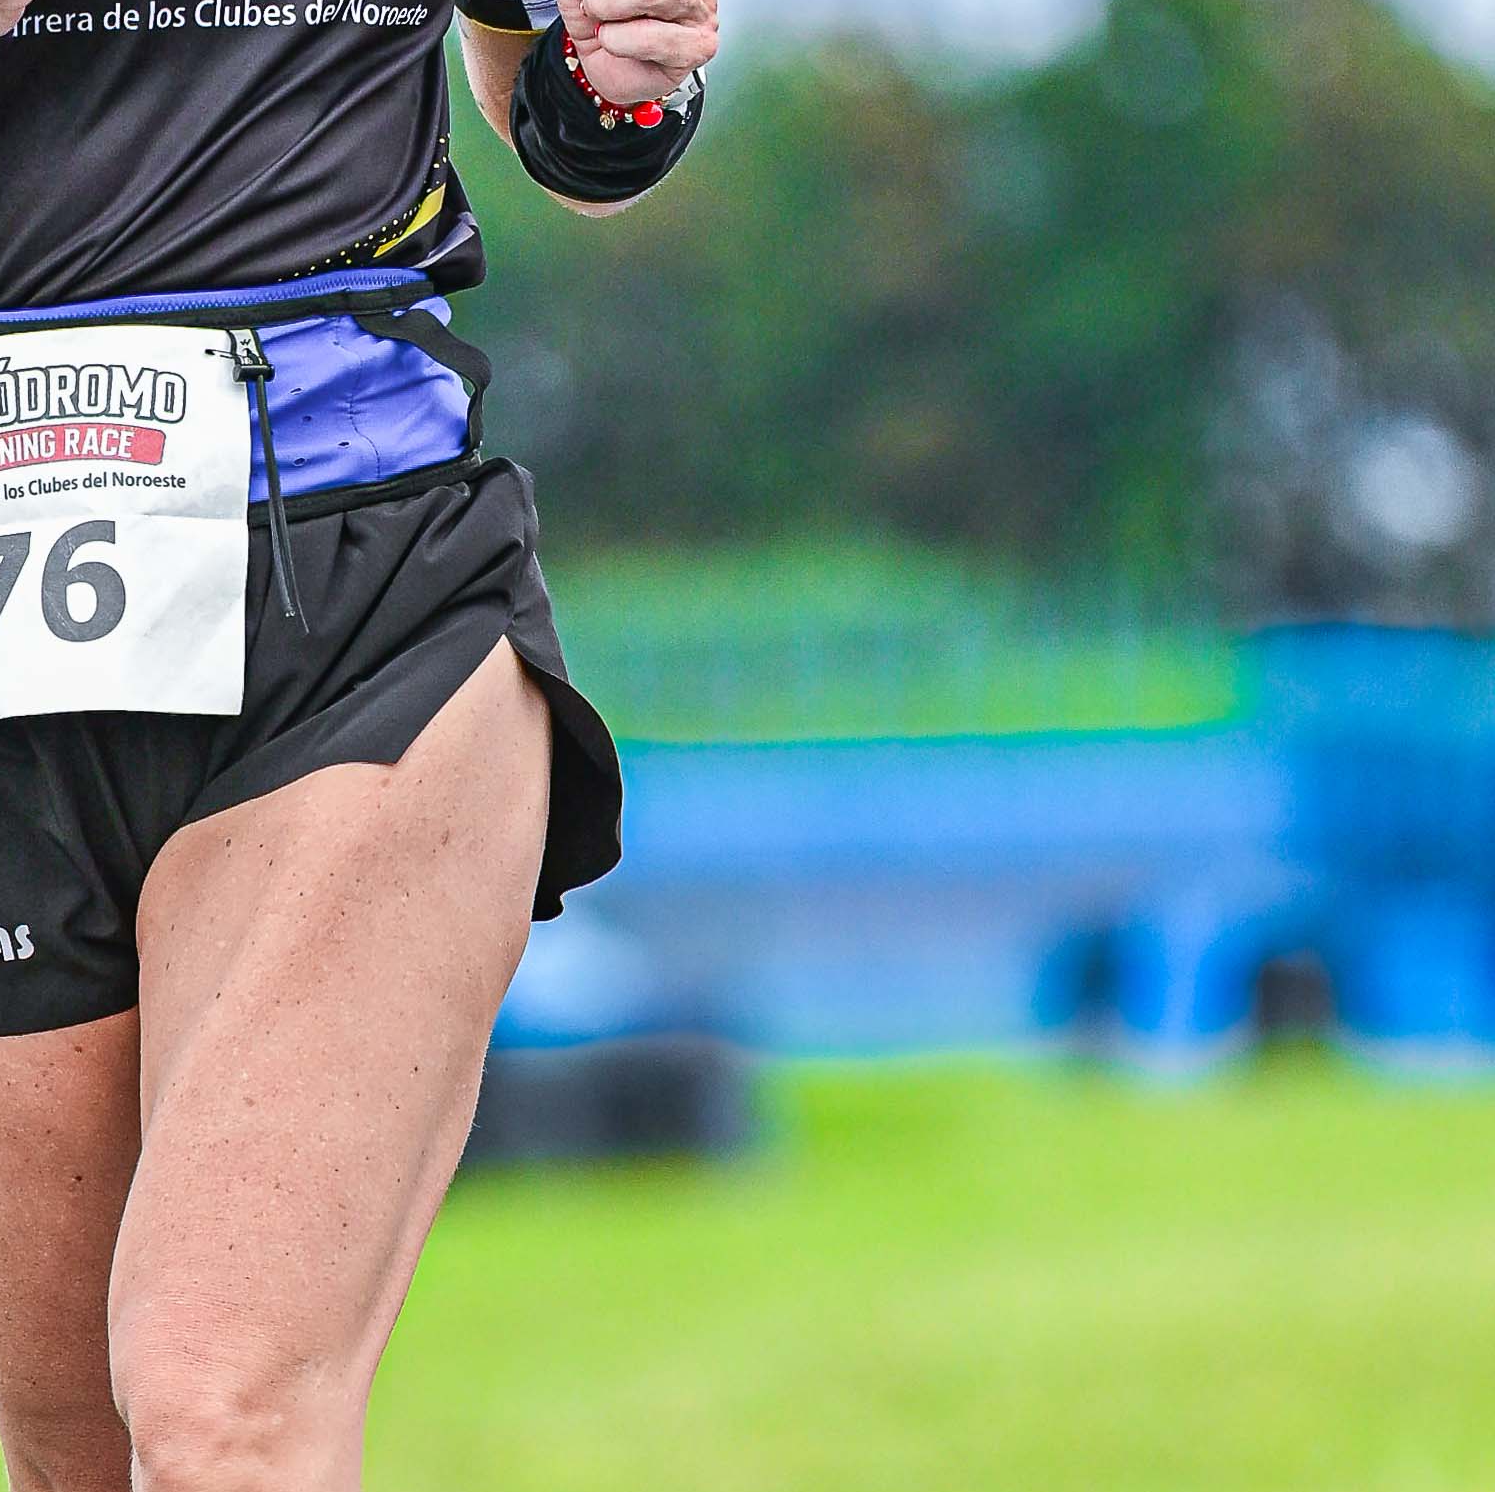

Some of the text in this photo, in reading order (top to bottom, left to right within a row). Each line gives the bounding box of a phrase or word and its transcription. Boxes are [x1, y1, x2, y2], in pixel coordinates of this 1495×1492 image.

[12, 8, 94, 38] rrera
[104, 3, 140, 31] de
[149, 0, 186, 30] los
[64, 427, 136, 458] RACE
[4, 481, 25, 500] los
[28, 477, 78, 496] Clubes
[82, 472, 108, 489] del
[112, 472, 187, 489] Noroeste
